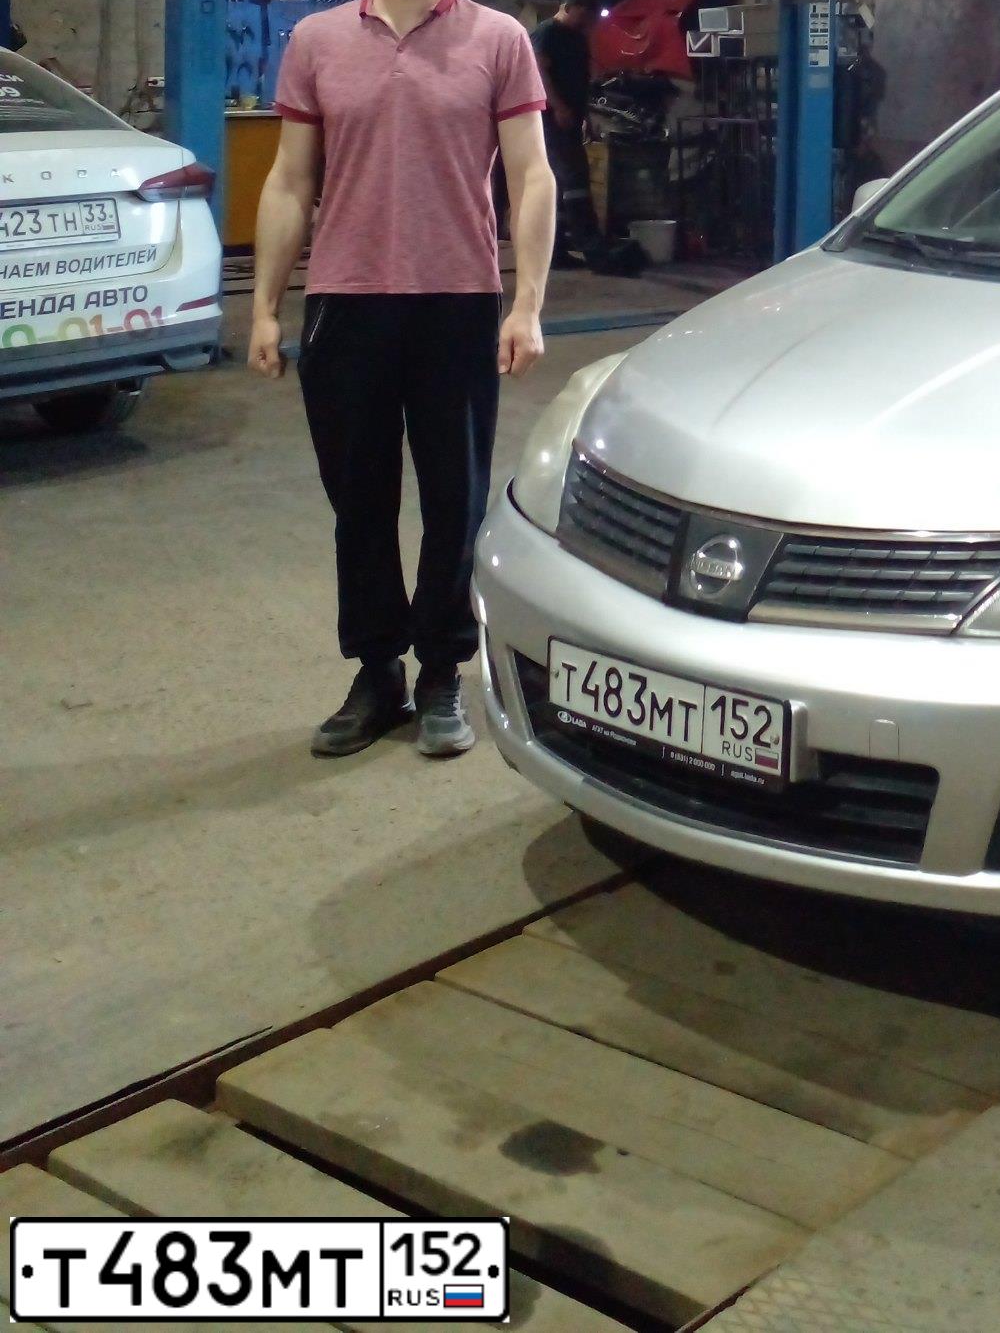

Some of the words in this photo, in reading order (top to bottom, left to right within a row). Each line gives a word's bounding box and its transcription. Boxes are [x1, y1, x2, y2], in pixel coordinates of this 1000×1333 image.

[83, 203, 107, 223] 33
[56, 245, 157, 274] ВОДИТЕЛЕЙ
[84, 285, 148, 309] АВТО
[561, 660, 698, 742] Т483МТ
[710, 695, 772, 748] 152
[721, 740, 754, 762] RUS
